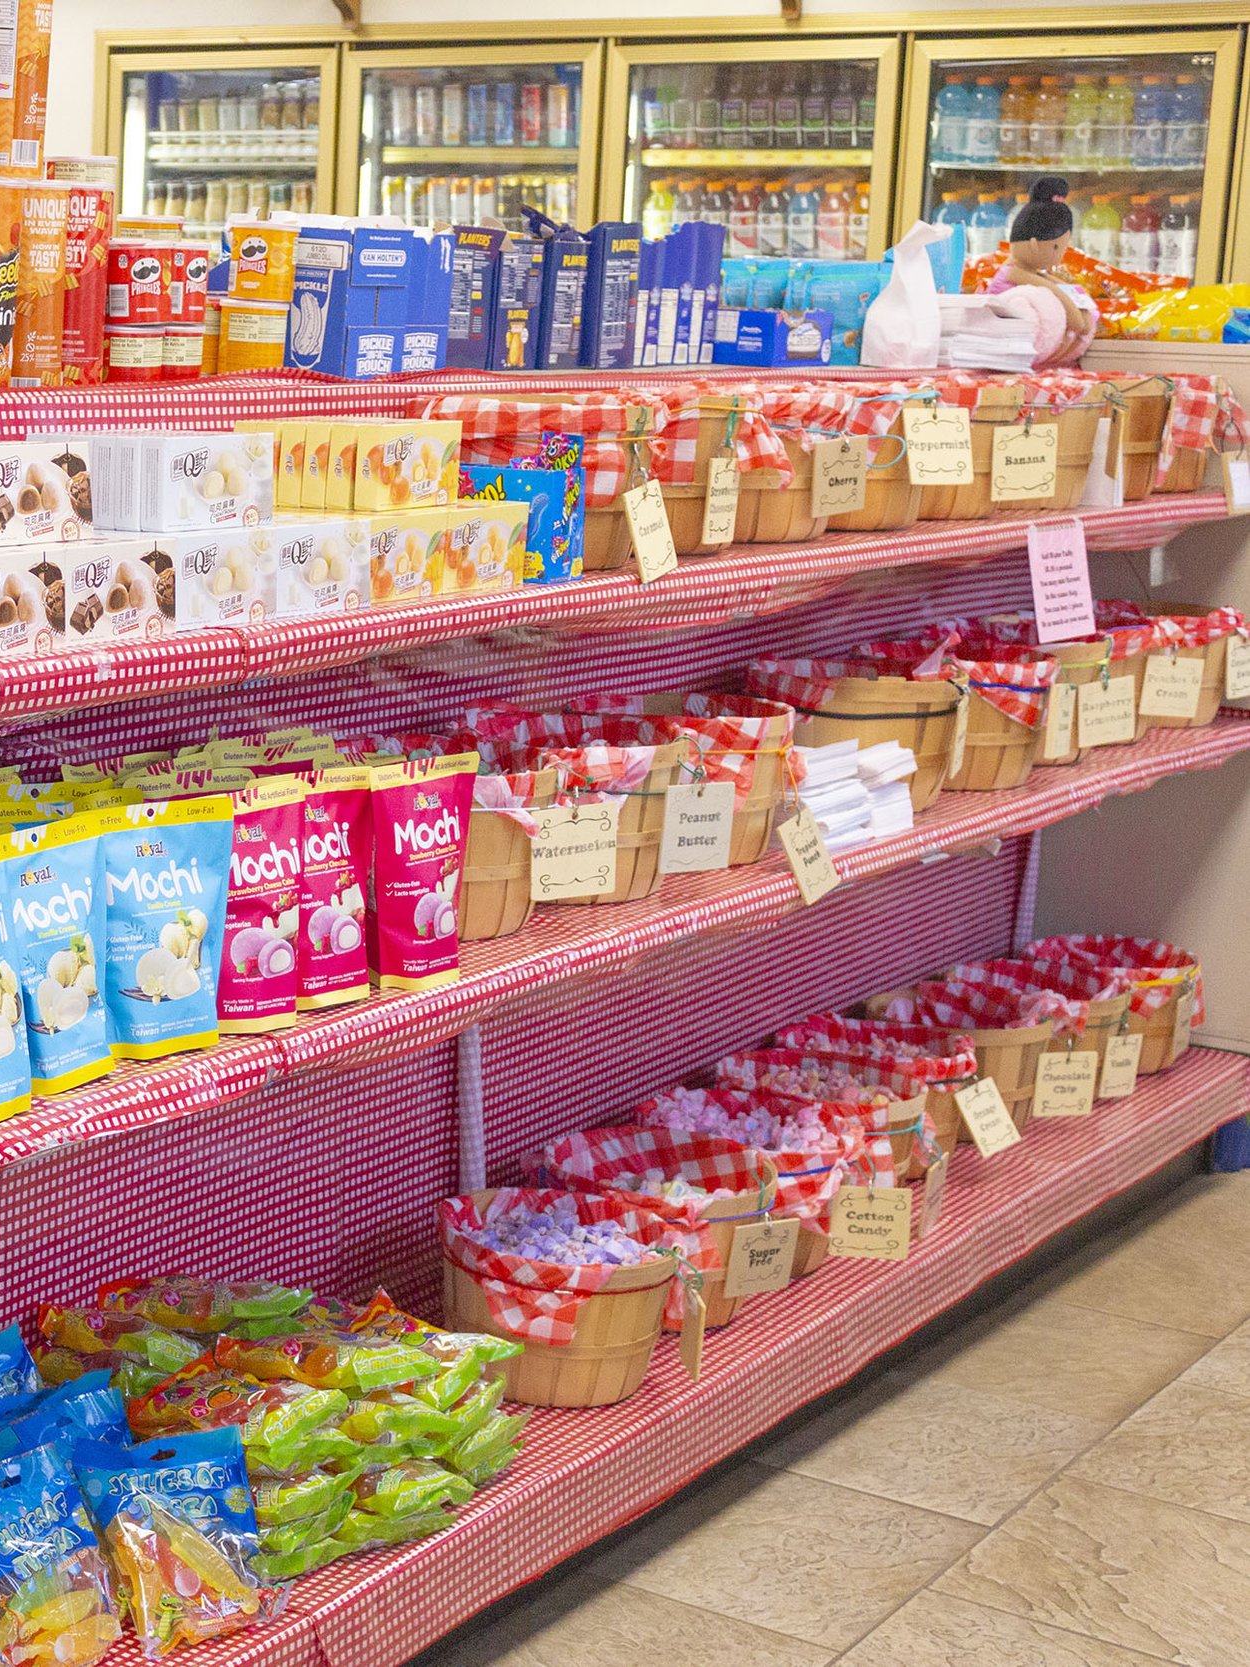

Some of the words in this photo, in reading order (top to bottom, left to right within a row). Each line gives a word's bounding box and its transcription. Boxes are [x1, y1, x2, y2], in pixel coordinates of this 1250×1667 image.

[458, 232, 492, 249] PLANTERS
[612, 239, 639, 253] PLANTERS
[30, 250, 61, 267] TASTY
[363, 253, 375, 261] VAN
[376, 254, 404, 263] HOLTEN'S
[238, 260, 266, 275] PRINGLES
[131, 282, 161, 296] PRINGLES
[295, 281, 329, 293] PICKLE
[508, 310, 529, 320] PLANTERS
[360, 338, 393, 351] PICKLE
[404, 335, 438, 349] PICKLE
[356, 359, 392, 376] POUCH
[403, 357, 435, 369] POUCH
[907, 438, 971, 452] Peppermint
[1004, 455, 1046, 466] Banana
[828, 476, 858, 488] Cherry
[1156, 689, 1188, 698] Cream
[223, 752, 258, 760] Gluten-Free
[136, 783, 171, 791] Gluten-Free
[268, 790, 286, 799] Artificial
[96, 795, 122, 808] Low-Fat
[679, 812, 721, 825] Peanut
[394, 806, 460, 854] Mochi
[677, 834, 717, 847] Butter
[135, 841, 164, 858] Royal
[532, 838, 616, 860] Watermelon
[795, 838, 819, 856] Tropical
[803, 851, 821, 868] Punch
[106, 857, 203, 905] Mochi
[402, 963, 428, 972] Taiwan
[303, 980, 328, 990] Taiwan
[223, 1003, 254, 1013] Taiwan
[130, 1027, 159, 1037] Taiwan
[1042, 1073, 1092, 1082] Chocolate
[1053, 1085, 1077, 1094] Chip
[846, 1211, 894, 1222] Cotton
[848, 1224, 892, 1237] Candy
[749, 1248, 781, 1259] Sugar
[750, 1257, 772, 1267] Free
